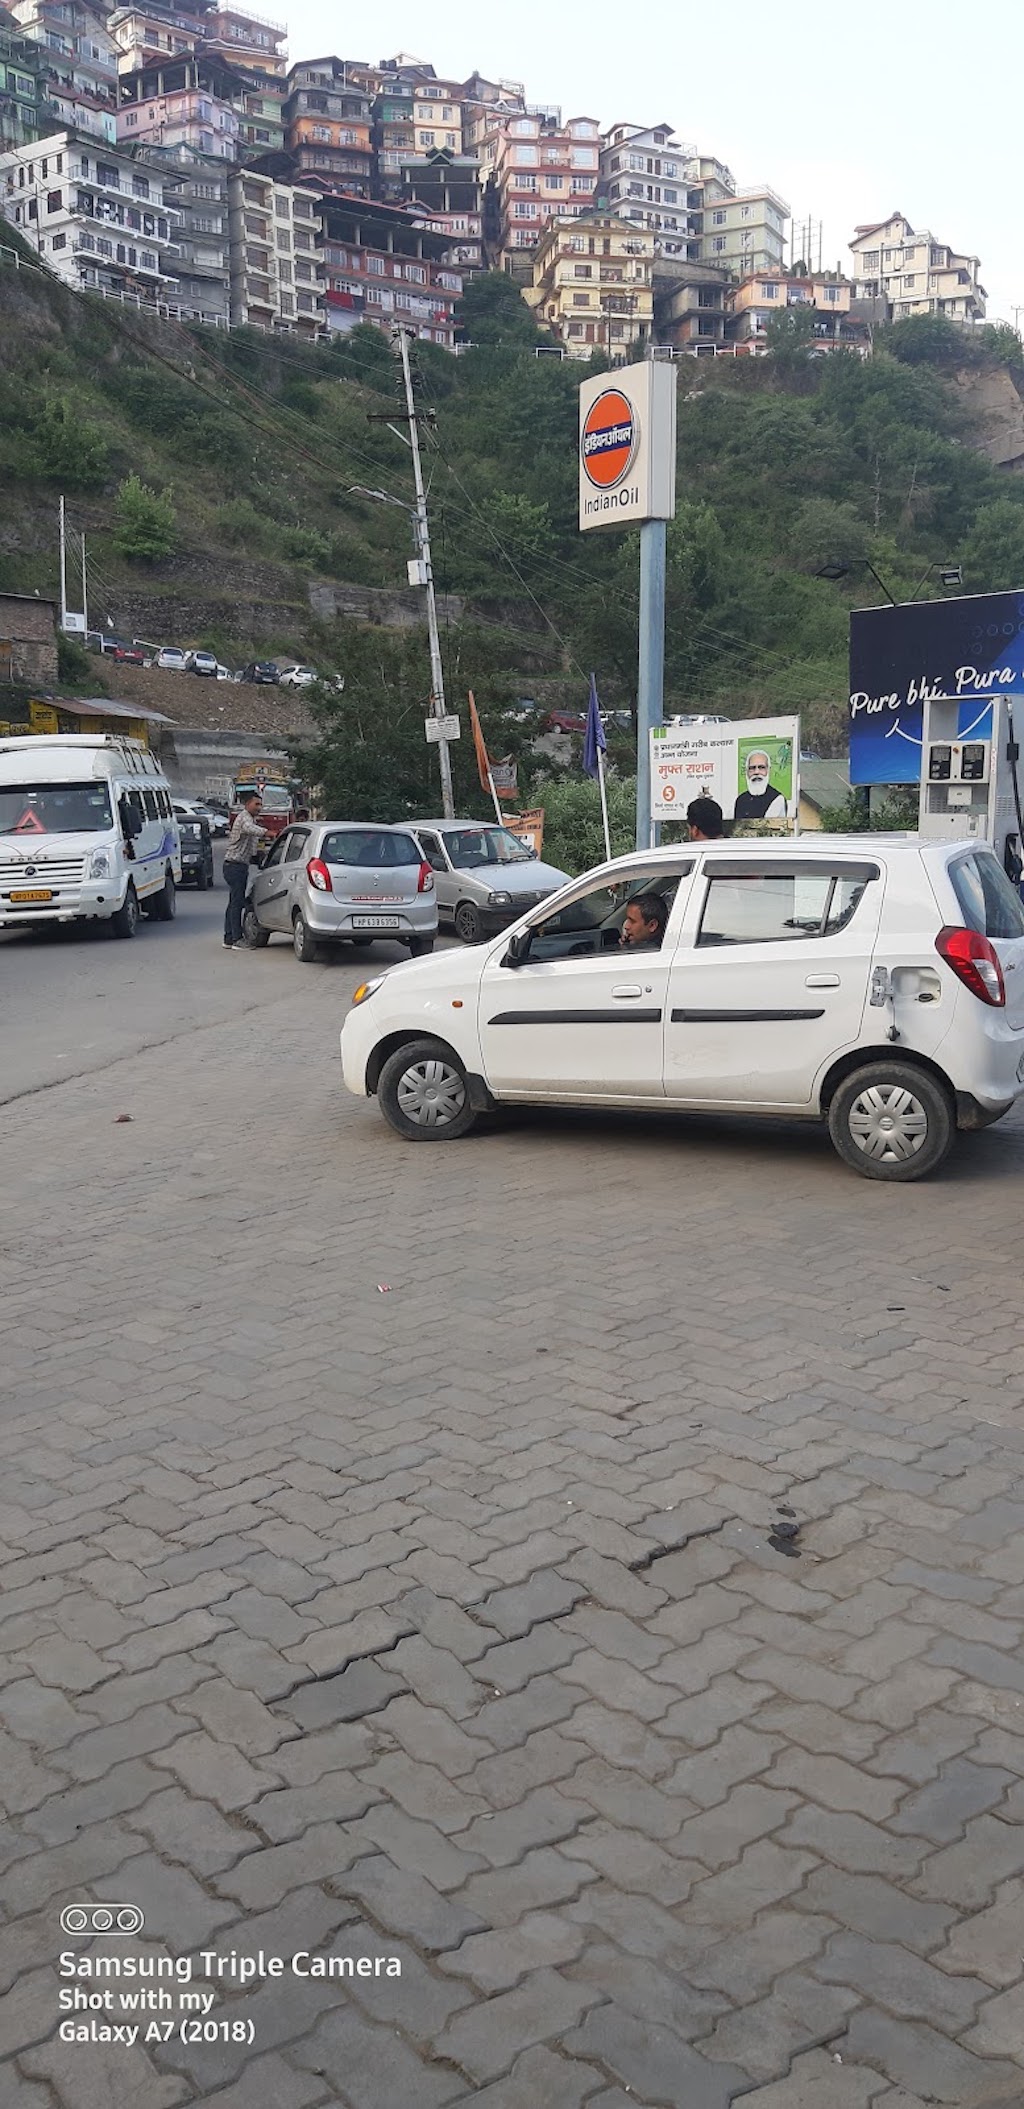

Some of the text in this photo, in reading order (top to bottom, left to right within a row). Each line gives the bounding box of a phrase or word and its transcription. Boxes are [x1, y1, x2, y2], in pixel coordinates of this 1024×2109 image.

[584, 487, 638, 515] IndianOil
[849, 692, 901, 719] Pure
[955, 666, 1017, 694] Pura
[658, 763, 714, 779] मुफ्त राशन
